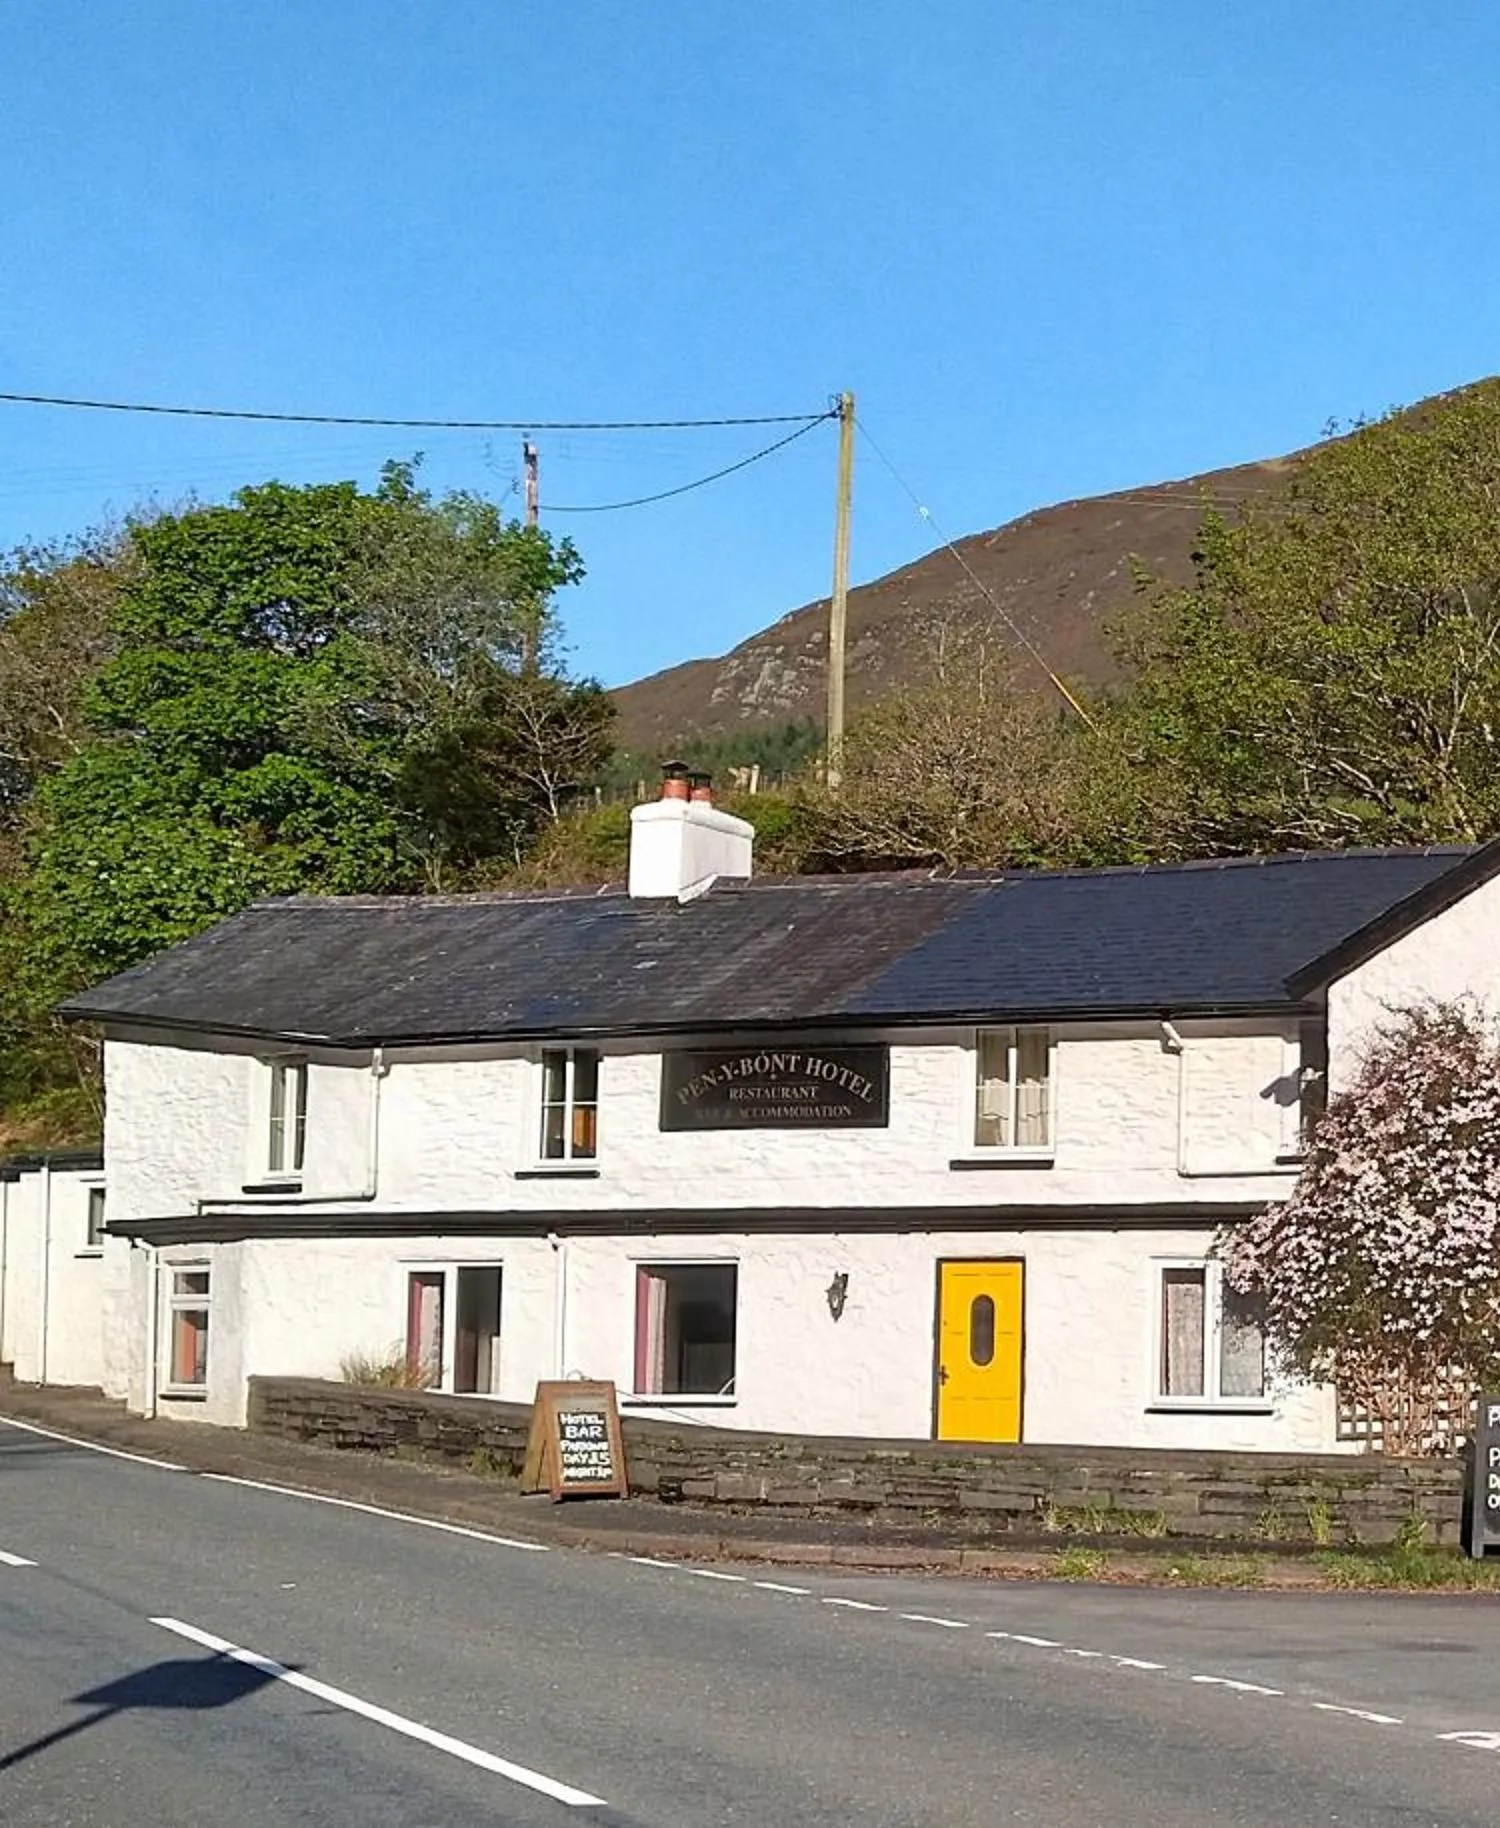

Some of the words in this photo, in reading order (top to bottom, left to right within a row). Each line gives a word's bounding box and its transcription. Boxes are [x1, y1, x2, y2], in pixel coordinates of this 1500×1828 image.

[805, 1057, 875, 1103] HOTEL
[729, 1086, 819, 1101] RESTAURANT
[739, 1105, 852, 1119] ACCOMMODATION
[560, 1413, 604, 1424] HOTEL
[565, 1425, 602, 1439] BAR
[564, 1451, 588, 1464] DAY
